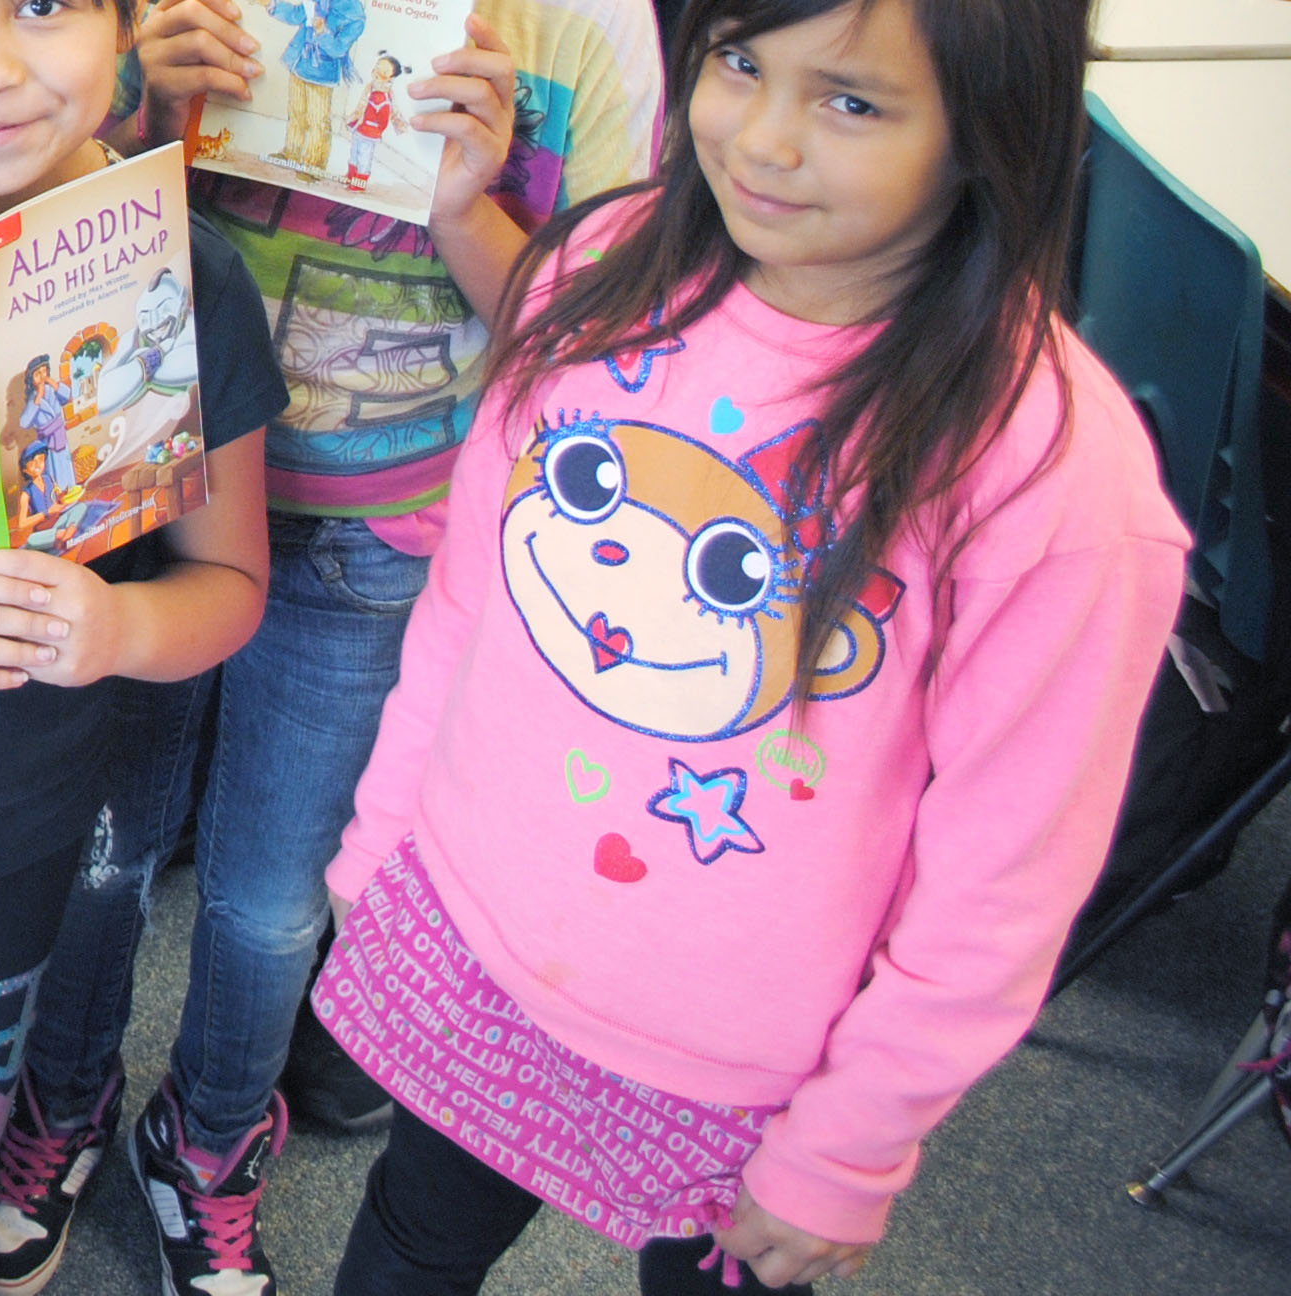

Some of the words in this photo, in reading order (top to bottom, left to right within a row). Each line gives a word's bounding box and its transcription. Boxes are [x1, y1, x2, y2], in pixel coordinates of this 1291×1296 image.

[371, 0, 402, 13] Betina
[405, 6, 439, 21] Ogden
[8, 188, 162, 287] ALADDIN
[8, 279, 56, 320] AND
[65, 258, 95, 292] HIS
[103, 229, 168, 275] LAMP
